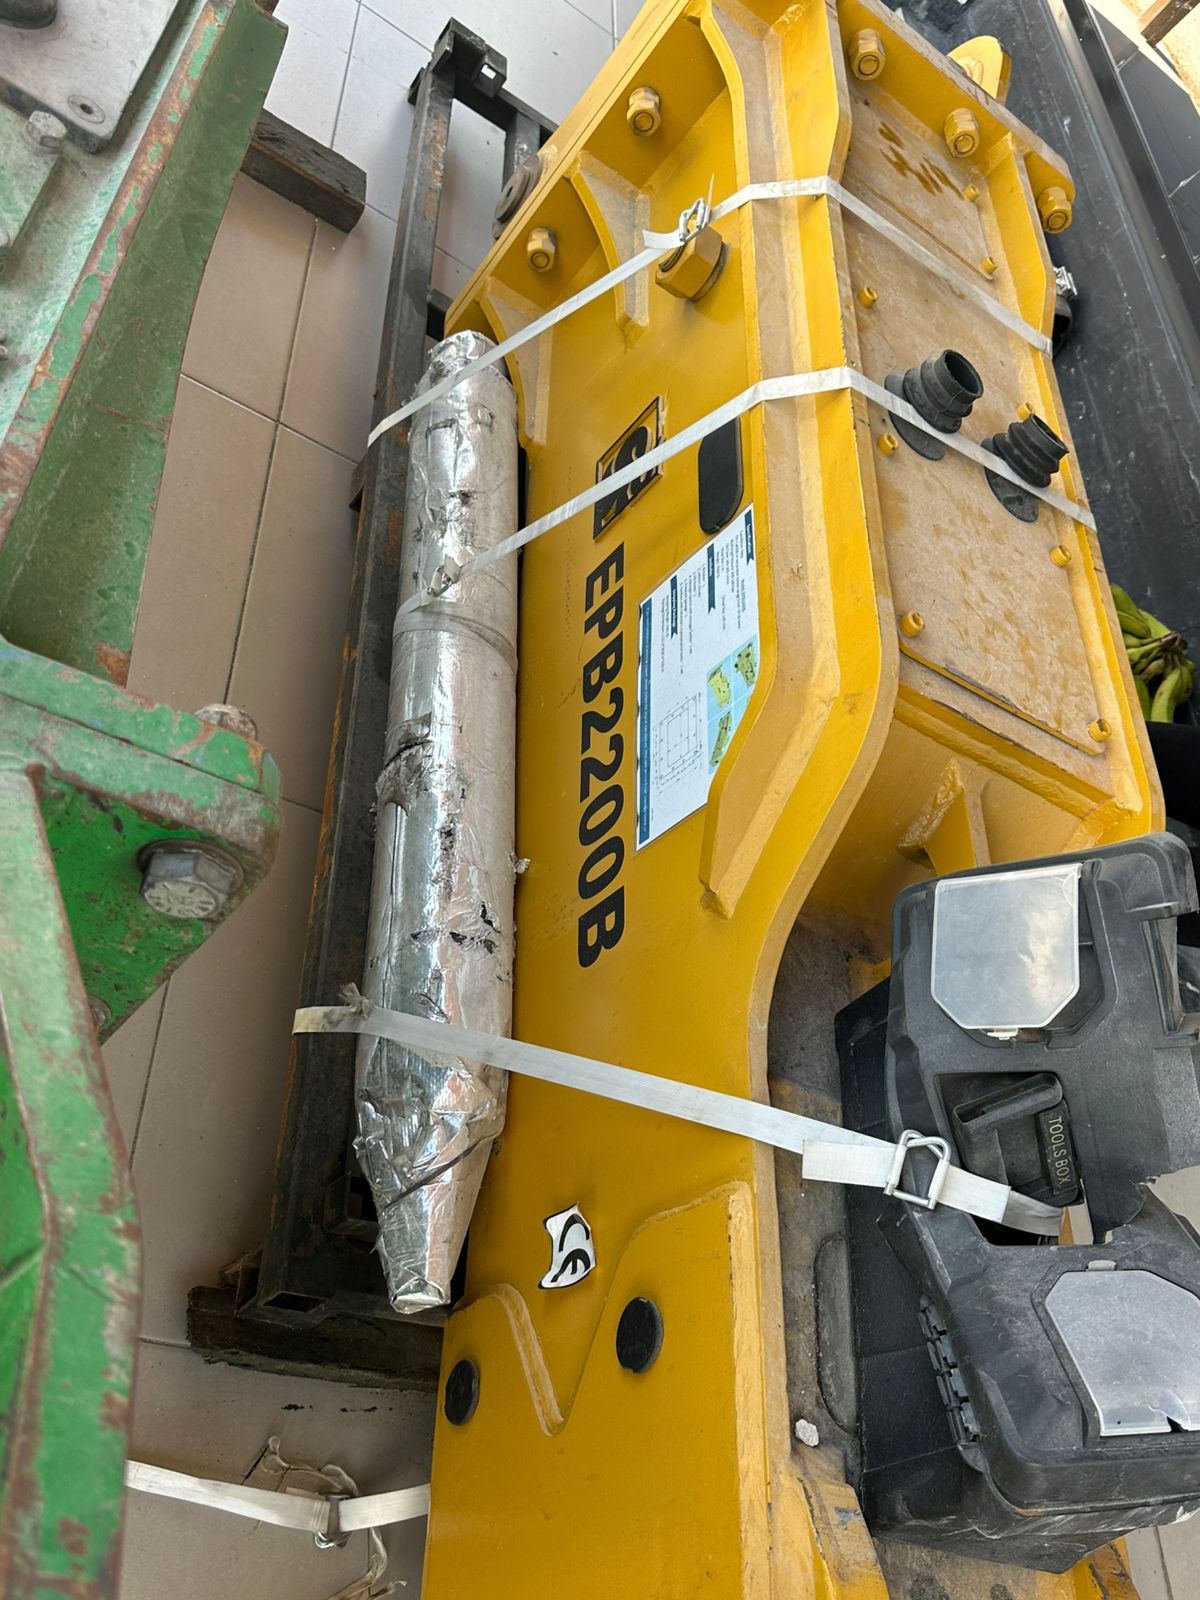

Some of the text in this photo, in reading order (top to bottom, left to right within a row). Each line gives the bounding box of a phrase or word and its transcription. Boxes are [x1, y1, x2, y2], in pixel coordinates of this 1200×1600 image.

[577, 541, 625, 968] EPB2200B
[1048, 1116, 1072, 1185] TOOLS BOX
[550, 1213, 591, 1283] CE
